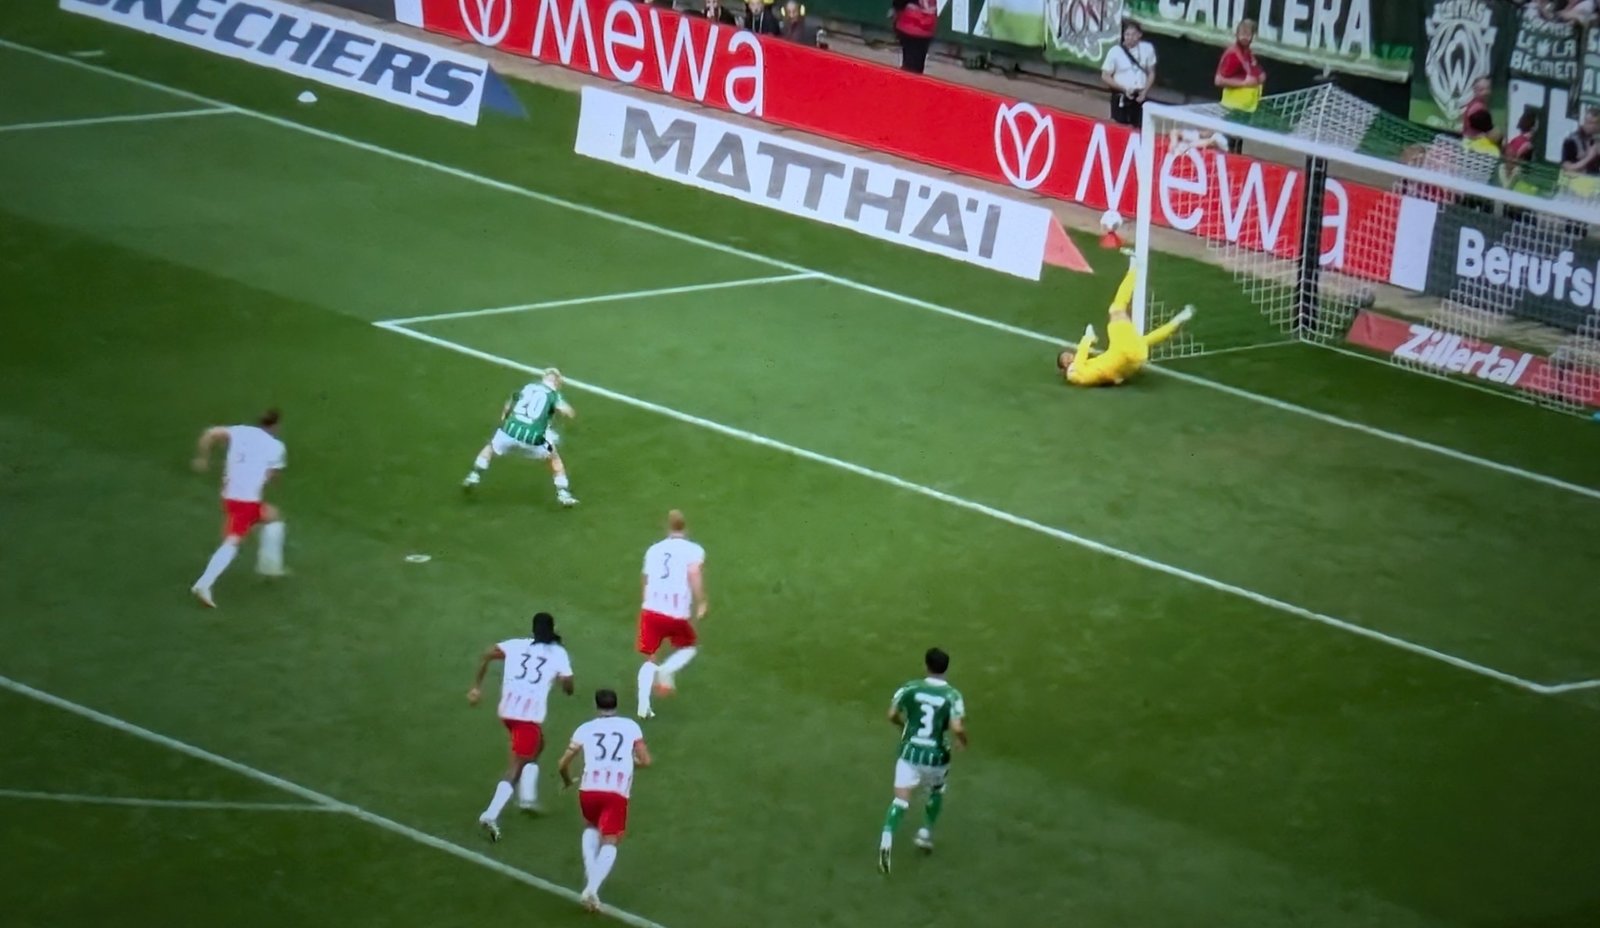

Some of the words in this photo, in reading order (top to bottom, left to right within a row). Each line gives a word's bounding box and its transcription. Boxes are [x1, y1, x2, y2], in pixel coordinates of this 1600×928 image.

[75, 0, 484, 107] KECHERS
[532, 0, 764, 117] Mewa
[620, 106, 1002, 259] MATTHÄI
[1394, 323, 1534, 386] Zillertal
[514, 391, 548, 420] 20
[660, 552, 672, 580] 3
[515, 653, 548, 685] 33
[917, 703, 935, 738] 3
[592, 731, 624, 762] 32
